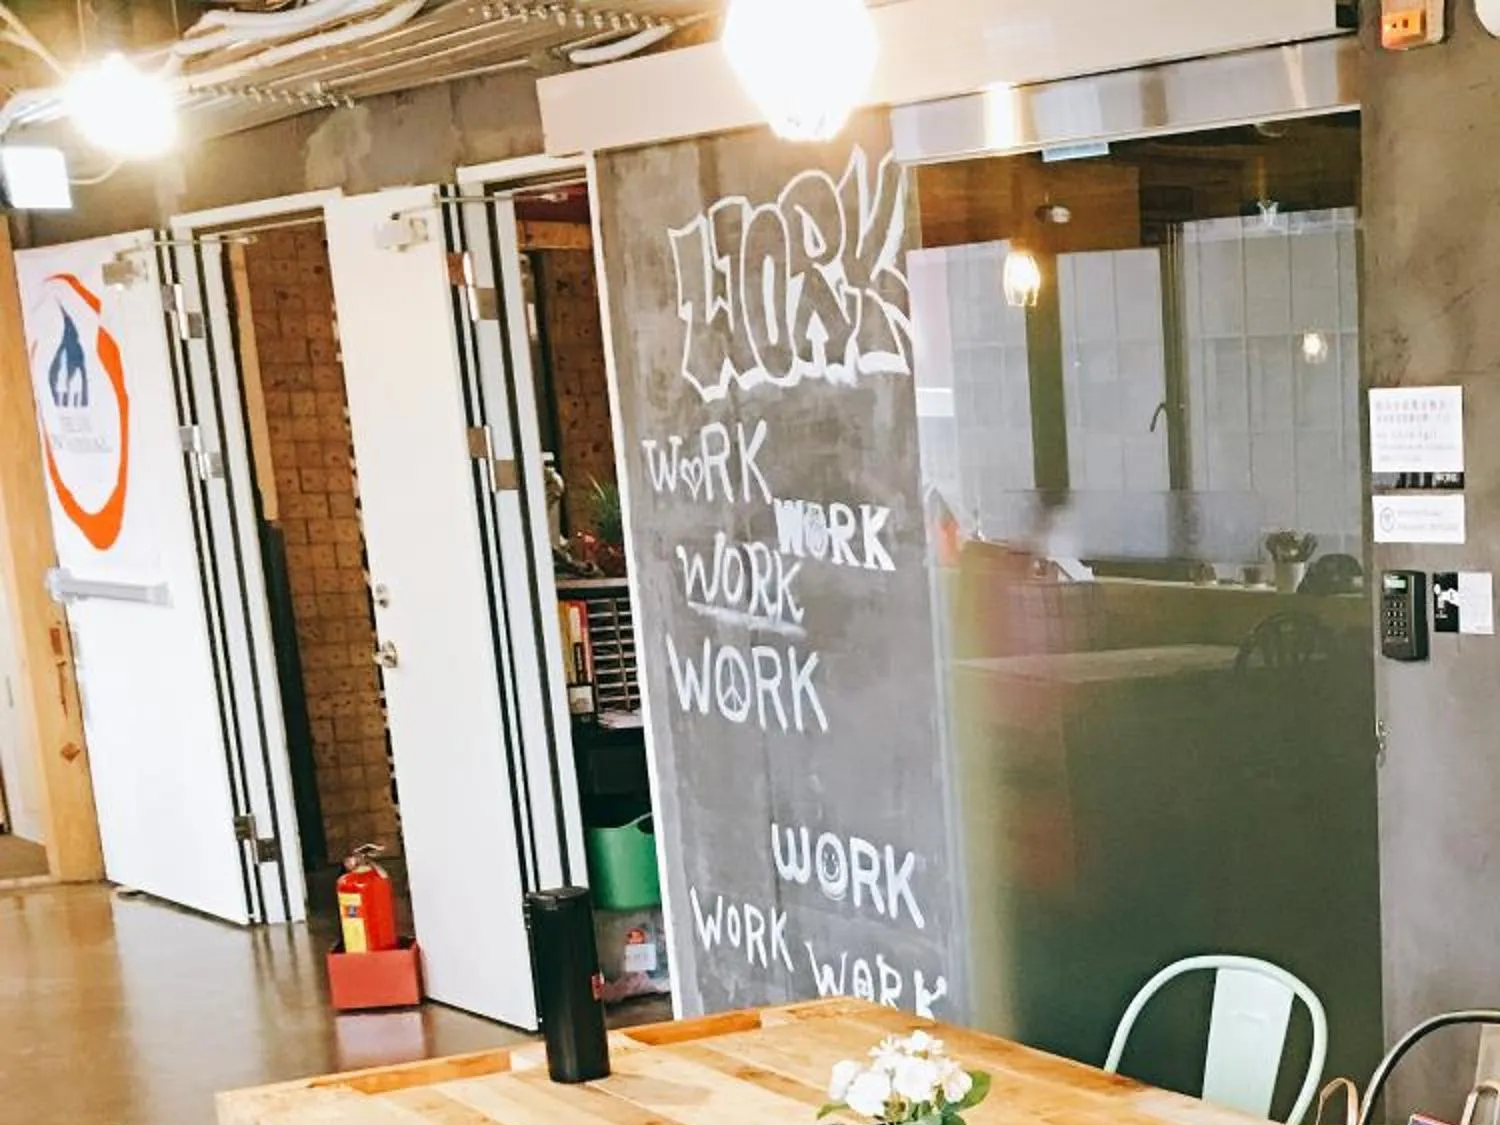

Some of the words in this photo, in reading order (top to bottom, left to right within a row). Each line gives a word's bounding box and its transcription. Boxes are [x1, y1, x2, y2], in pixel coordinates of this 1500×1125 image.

[675, 530, 805, 624] WORK
[772, 498, 897, 571] WORK
[665, 634, 829, 733] WORK
[771, 823, 925, 929] WORK
[690, 886, 795, 973] WORK
[804, 940, 948, 1021] WORK
